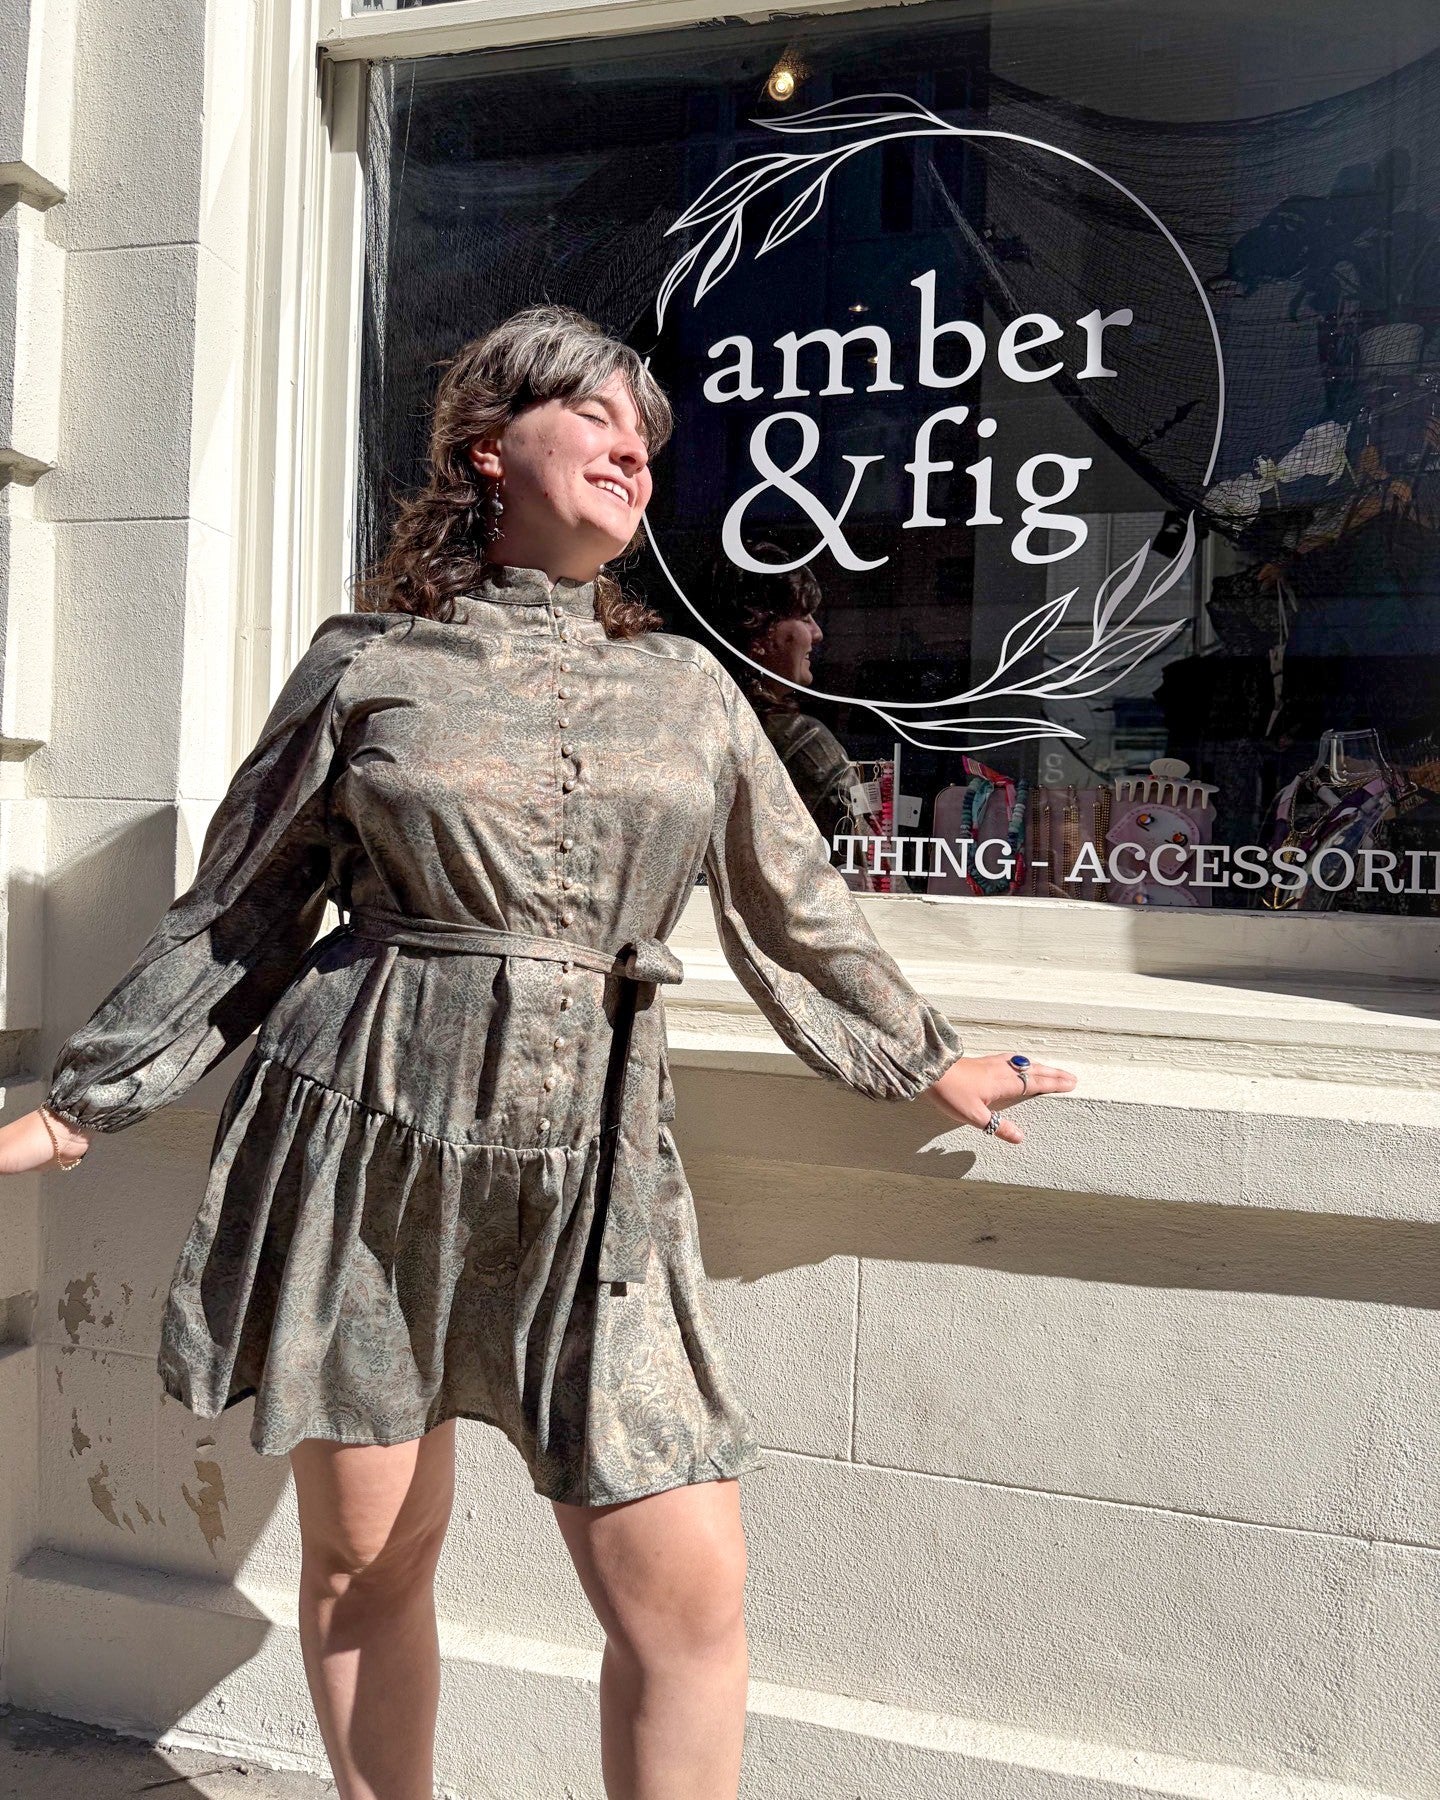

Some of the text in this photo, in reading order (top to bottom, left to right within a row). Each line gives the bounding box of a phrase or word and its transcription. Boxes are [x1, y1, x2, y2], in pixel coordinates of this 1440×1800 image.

[703, 269, 1134, 404] amber
[721, 406, 1093, 574] & fig
[822, 834, 1016, 882] THING
